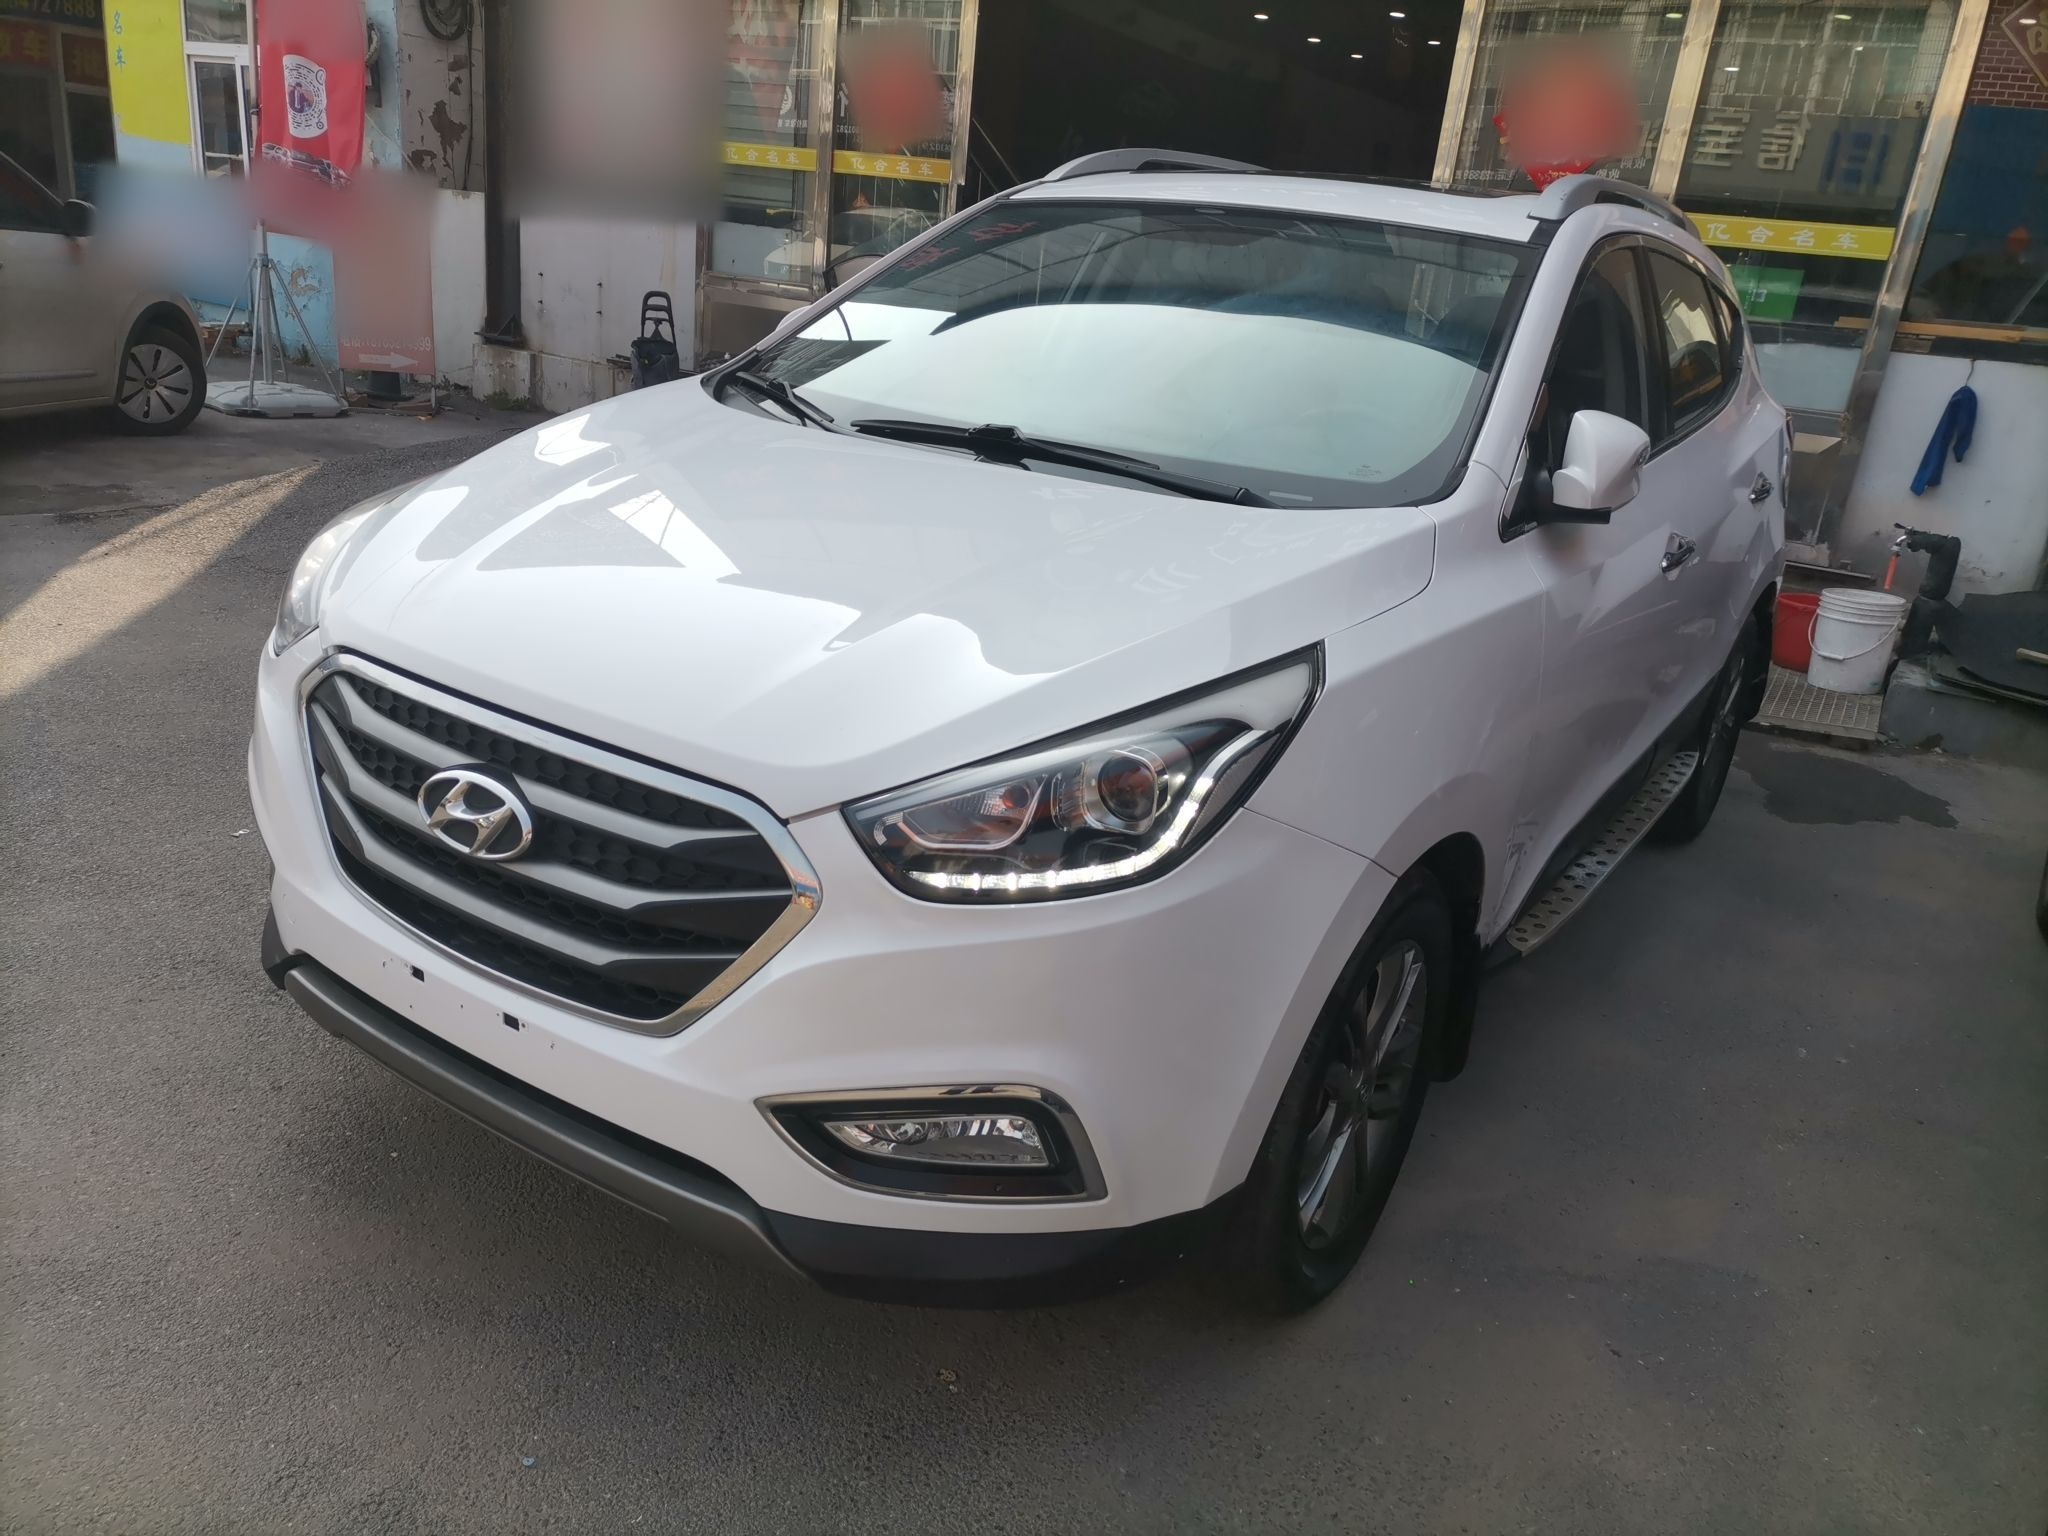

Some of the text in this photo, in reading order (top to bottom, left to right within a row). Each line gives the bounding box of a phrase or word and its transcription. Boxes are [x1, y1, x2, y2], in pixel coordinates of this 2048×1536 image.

[113, 10, 127, 73] 名车
[851, 157, 933, 175] 亿合名车
[1706, 222, 1859, 249] 亿合名车
